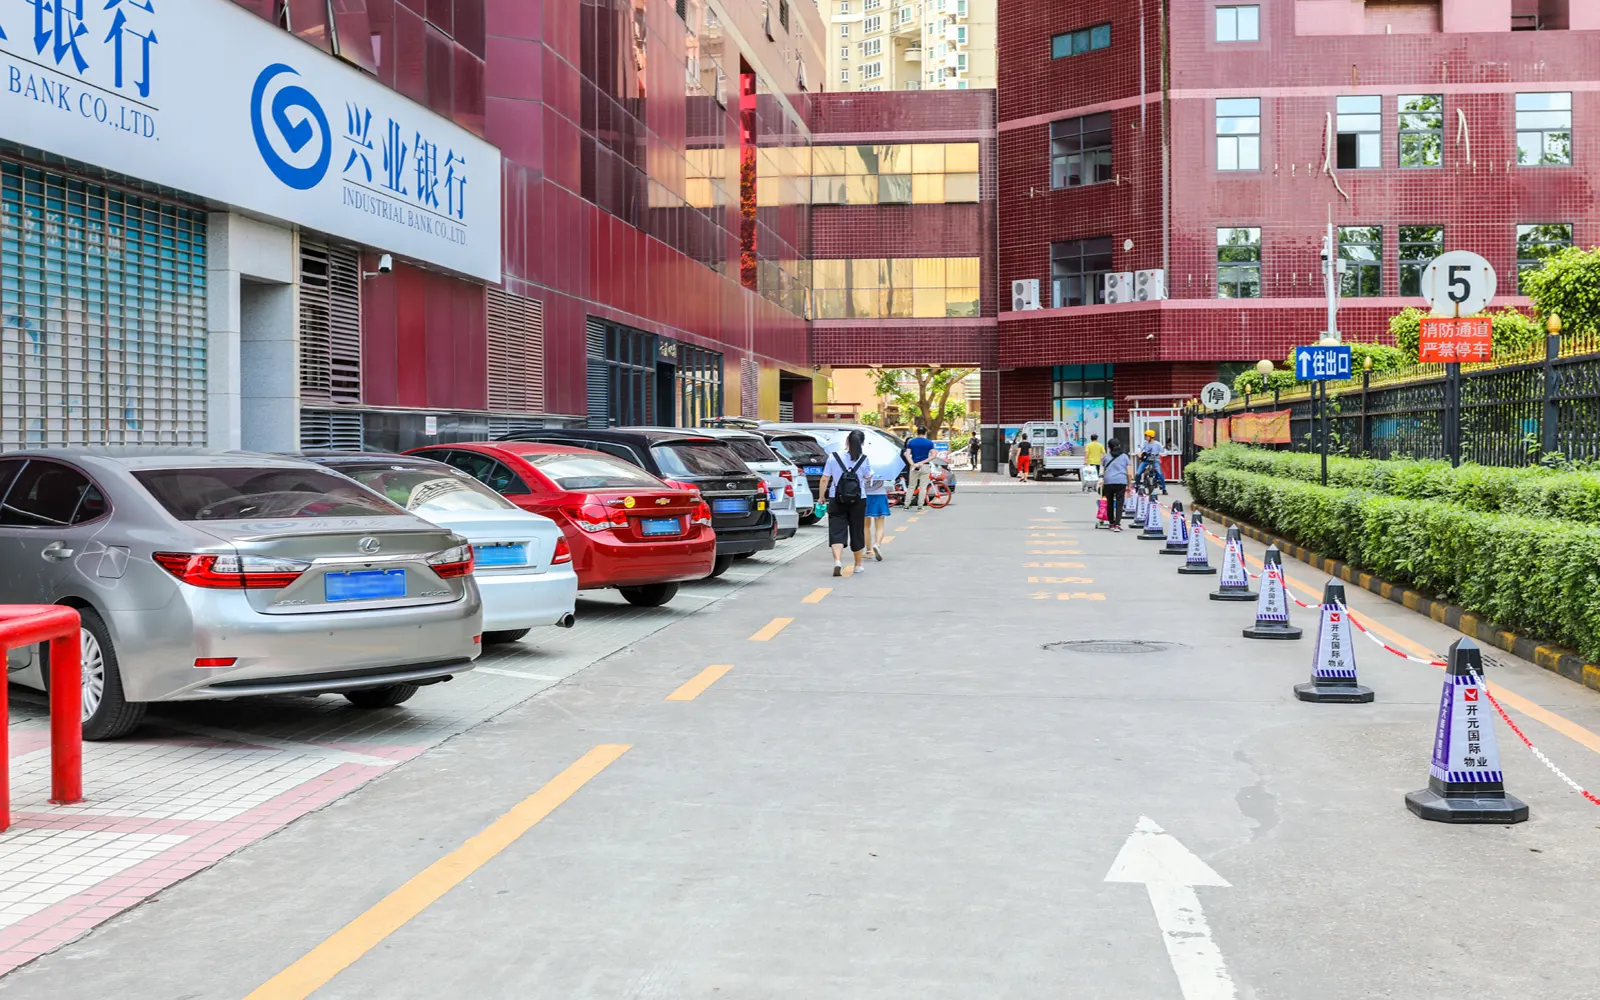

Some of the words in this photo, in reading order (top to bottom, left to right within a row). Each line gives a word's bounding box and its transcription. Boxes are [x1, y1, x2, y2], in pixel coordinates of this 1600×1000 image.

[0, 0, 158, 97] 银行
[8, 65, 72, 112] BANK
[79, 92, 160, 142] CO.,LTD.
[343, 100, 467, 220] 兴业银行
[343, 186, 405, 225] INDUSTRIAL
[408, 210, 433, 235] BANK
[1447, 265, 1472, 303] 5
[1422, 322, 1489, 338] 消防通道
[1313, 350, 1348, 376] 往出口
[1422, 341, 1489, 358] 严禁停车
[1207, 387, 1225, 405] 停
[1331, 624, 1341, 659] 开元国际
[1328, 660, 1345, 668] 物业
[1466, 705, 1481, 755] 开元国际
[1464, 756, 1488, 767] 物业
